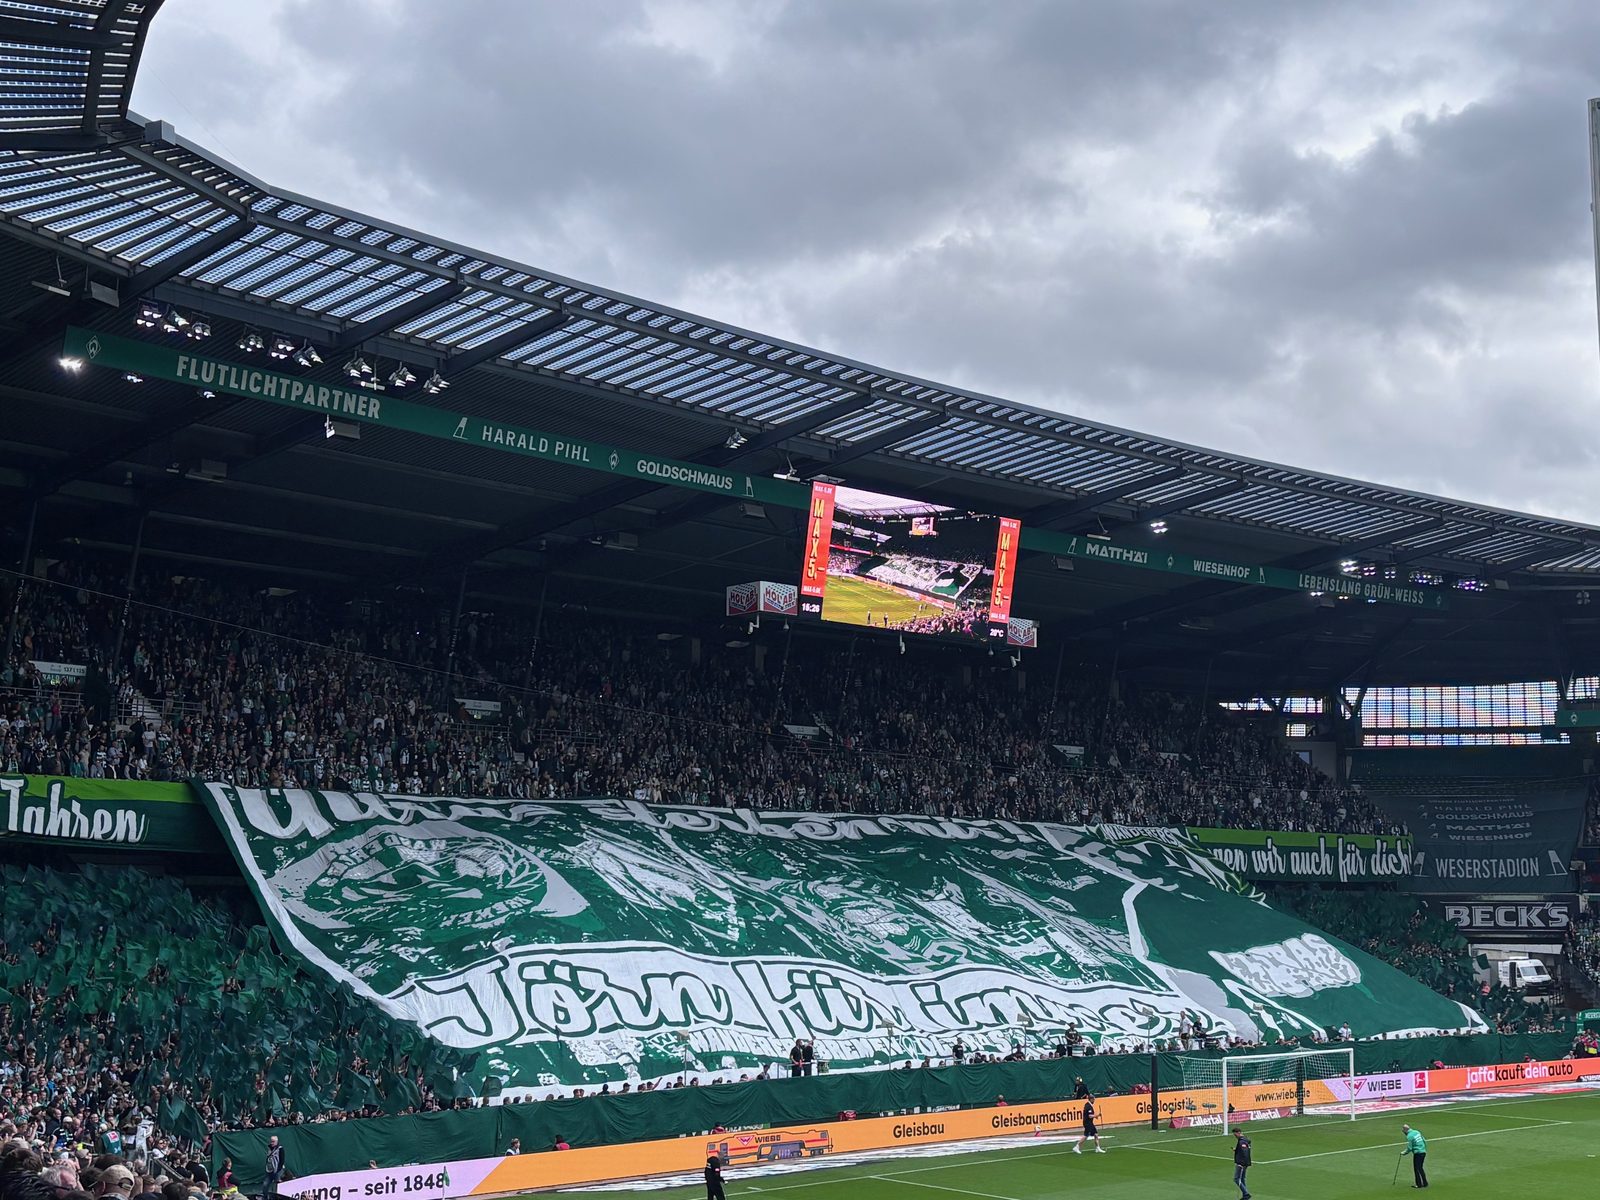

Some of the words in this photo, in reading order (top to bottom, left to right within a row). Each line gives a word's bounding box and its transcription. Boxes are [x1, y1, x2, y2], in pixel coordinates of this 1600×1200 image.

[176, 355, 381, 420] FLUTLICHTPARTNER
[481, 425, 549, 454] HARALD
[554, 441, 591, 463] PIHL
[636, 459, 733, 490] GOLDSCHMAUS
[1085, 541, 1148, 564] MATTHÄI
[1193, 559, 1250, 579] WIESENHOF
[1298, 573, 1361, 596] LEBENSLANG
[1364, 582, 1424, 605] GRÜN-WEISS
[1435, 811, 1534, 821] GOLDSCHMAUS
[1100, 823, 1179, 847] WANDERERS
[1449, 832, 1533, 841] WIESENHOF
[1252, 838, 1287, 876] wir
[1291, 837, 1335, 876] auch
[1337, 837, 1367, 883] für
[1435, 857, 1540, 879] WESERSTADION
[1444, 902, 1570, 928] BECK'S
[414, 954, 733, 1046] Jörn
[1367, 1079, 1402, 1092] WIEBE
[1188, 1114, 1222, 1127] Zillertal
[1248, 1108, 1281, 1121] Zillertal
[893, 1122, 945, 1139] Gleisbau
[364, 1176, 397, 1196] seit
[403, 1172, 445, 1193] 1848
